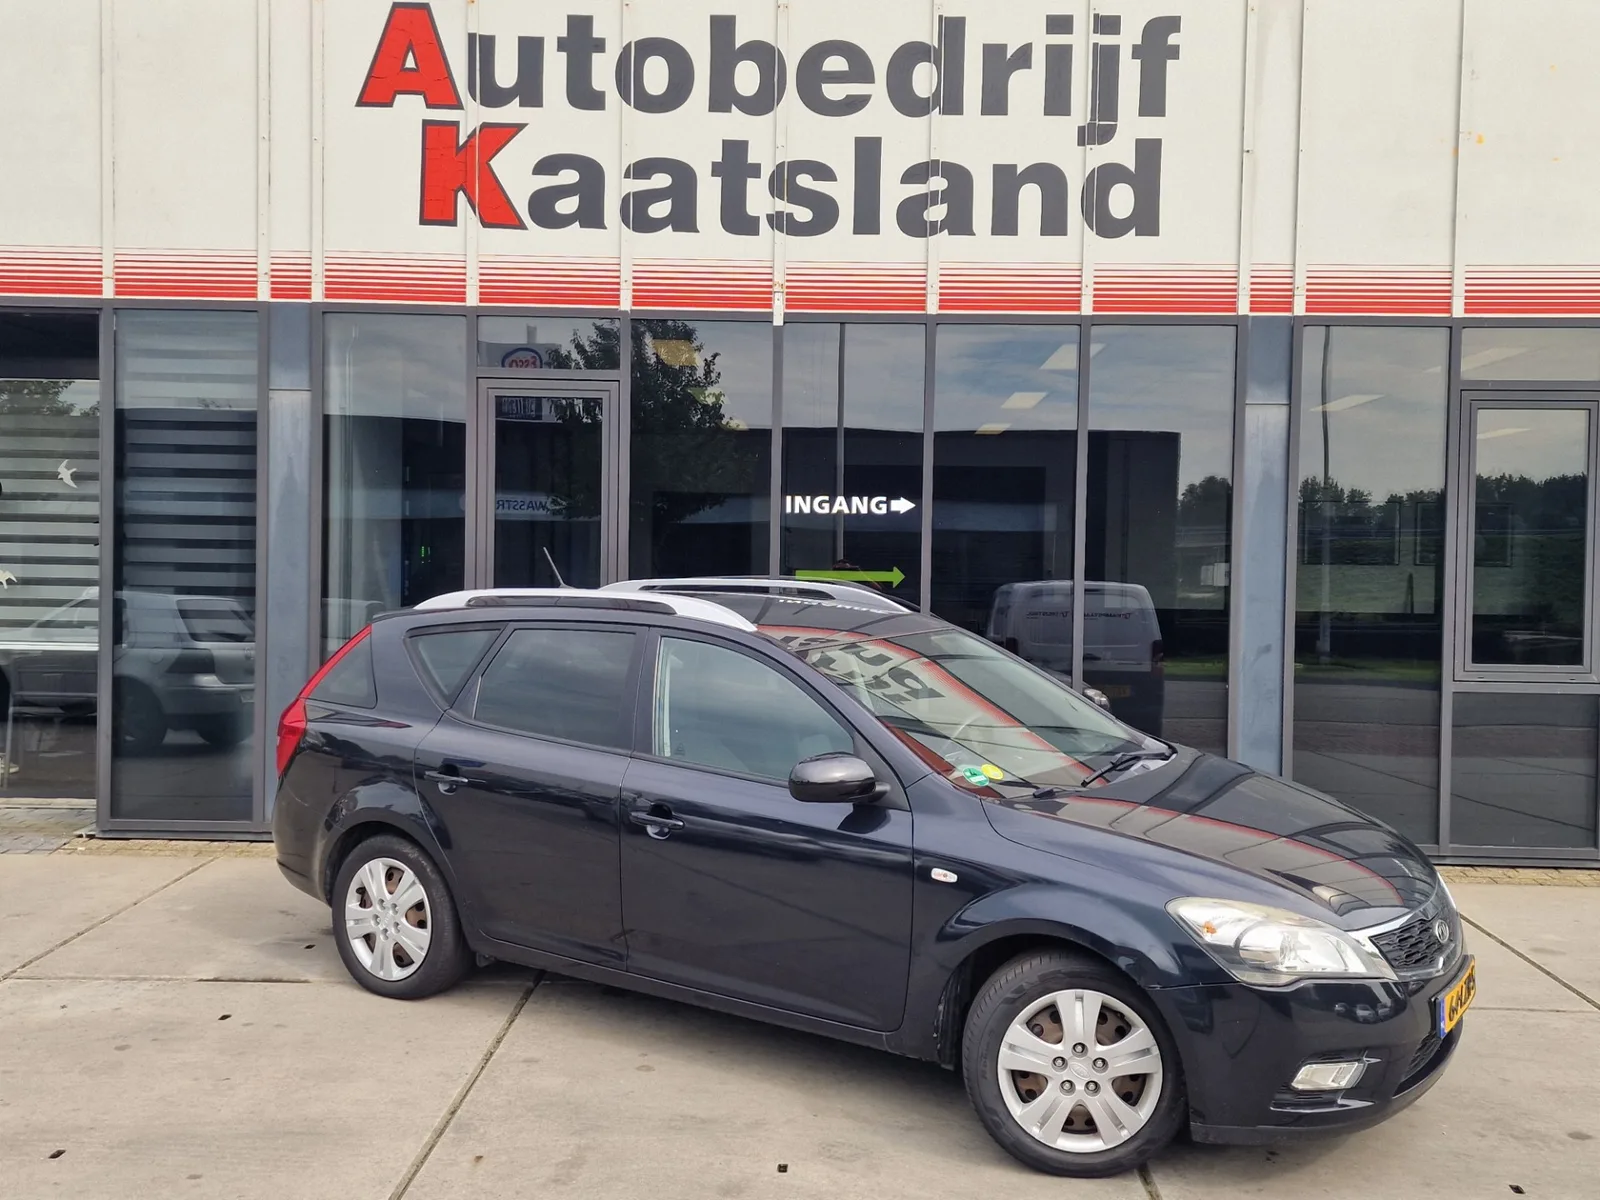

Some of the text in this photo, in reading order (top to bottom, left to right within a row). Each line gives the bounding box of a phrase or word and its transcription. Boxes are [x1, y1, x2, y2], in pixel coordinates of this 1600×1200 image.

[356, 2, 1180, 146] Autobedrijf
[419, 120, 1163, 238] Kaatsland
[785, 495, 888, 514] INGANG
